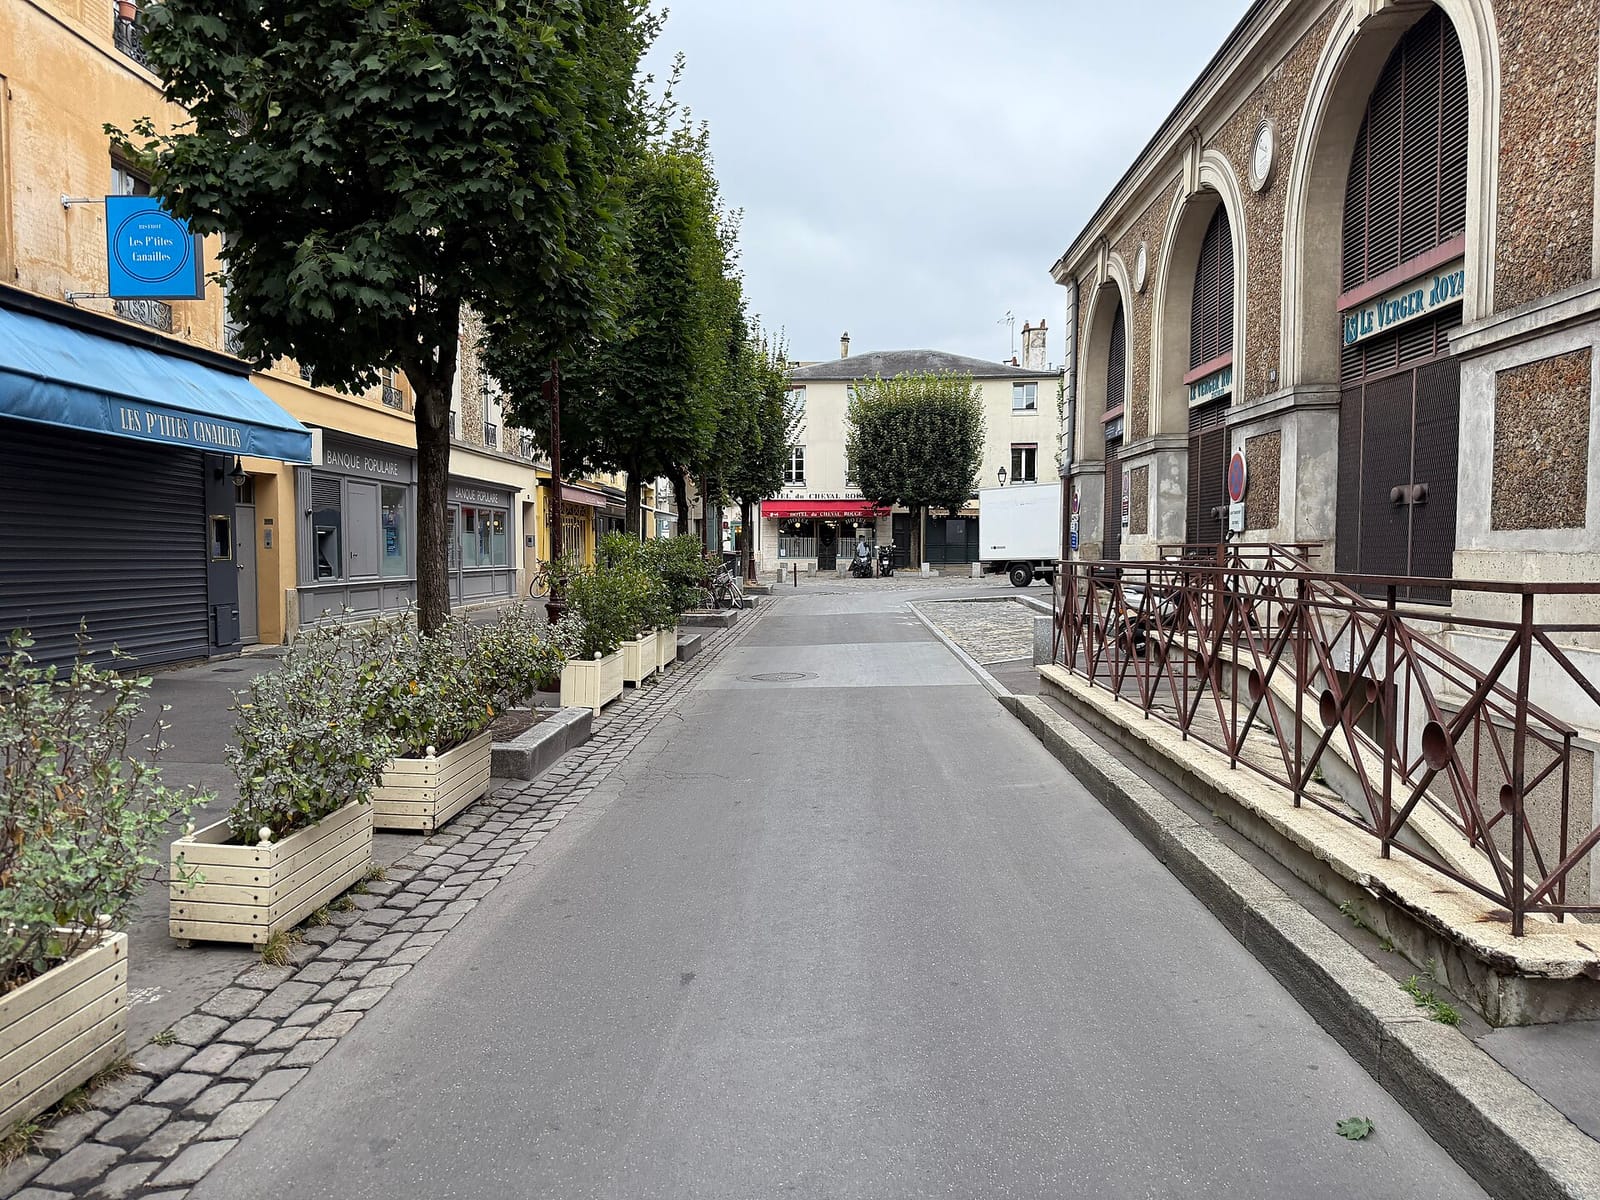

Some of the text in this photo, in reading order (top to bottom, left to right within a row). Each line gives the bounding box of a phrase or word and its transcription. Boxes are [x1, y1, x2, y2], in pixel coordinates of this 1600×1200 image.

[129, 235, 174, 247] Les P'tites
[132, 251, 171, 262] Canailles
[1359, 269, 1465, 336] LE VERGER ROYA
[1197, 374, 1220, 397] VERGER
[119, 407, 241, 448] LES P'TITES CANAILLES
[327, 450, 398, 476] BANQUE POPULAIRE
[455, 487, 498, 504] BANQUE POPULAIRE
